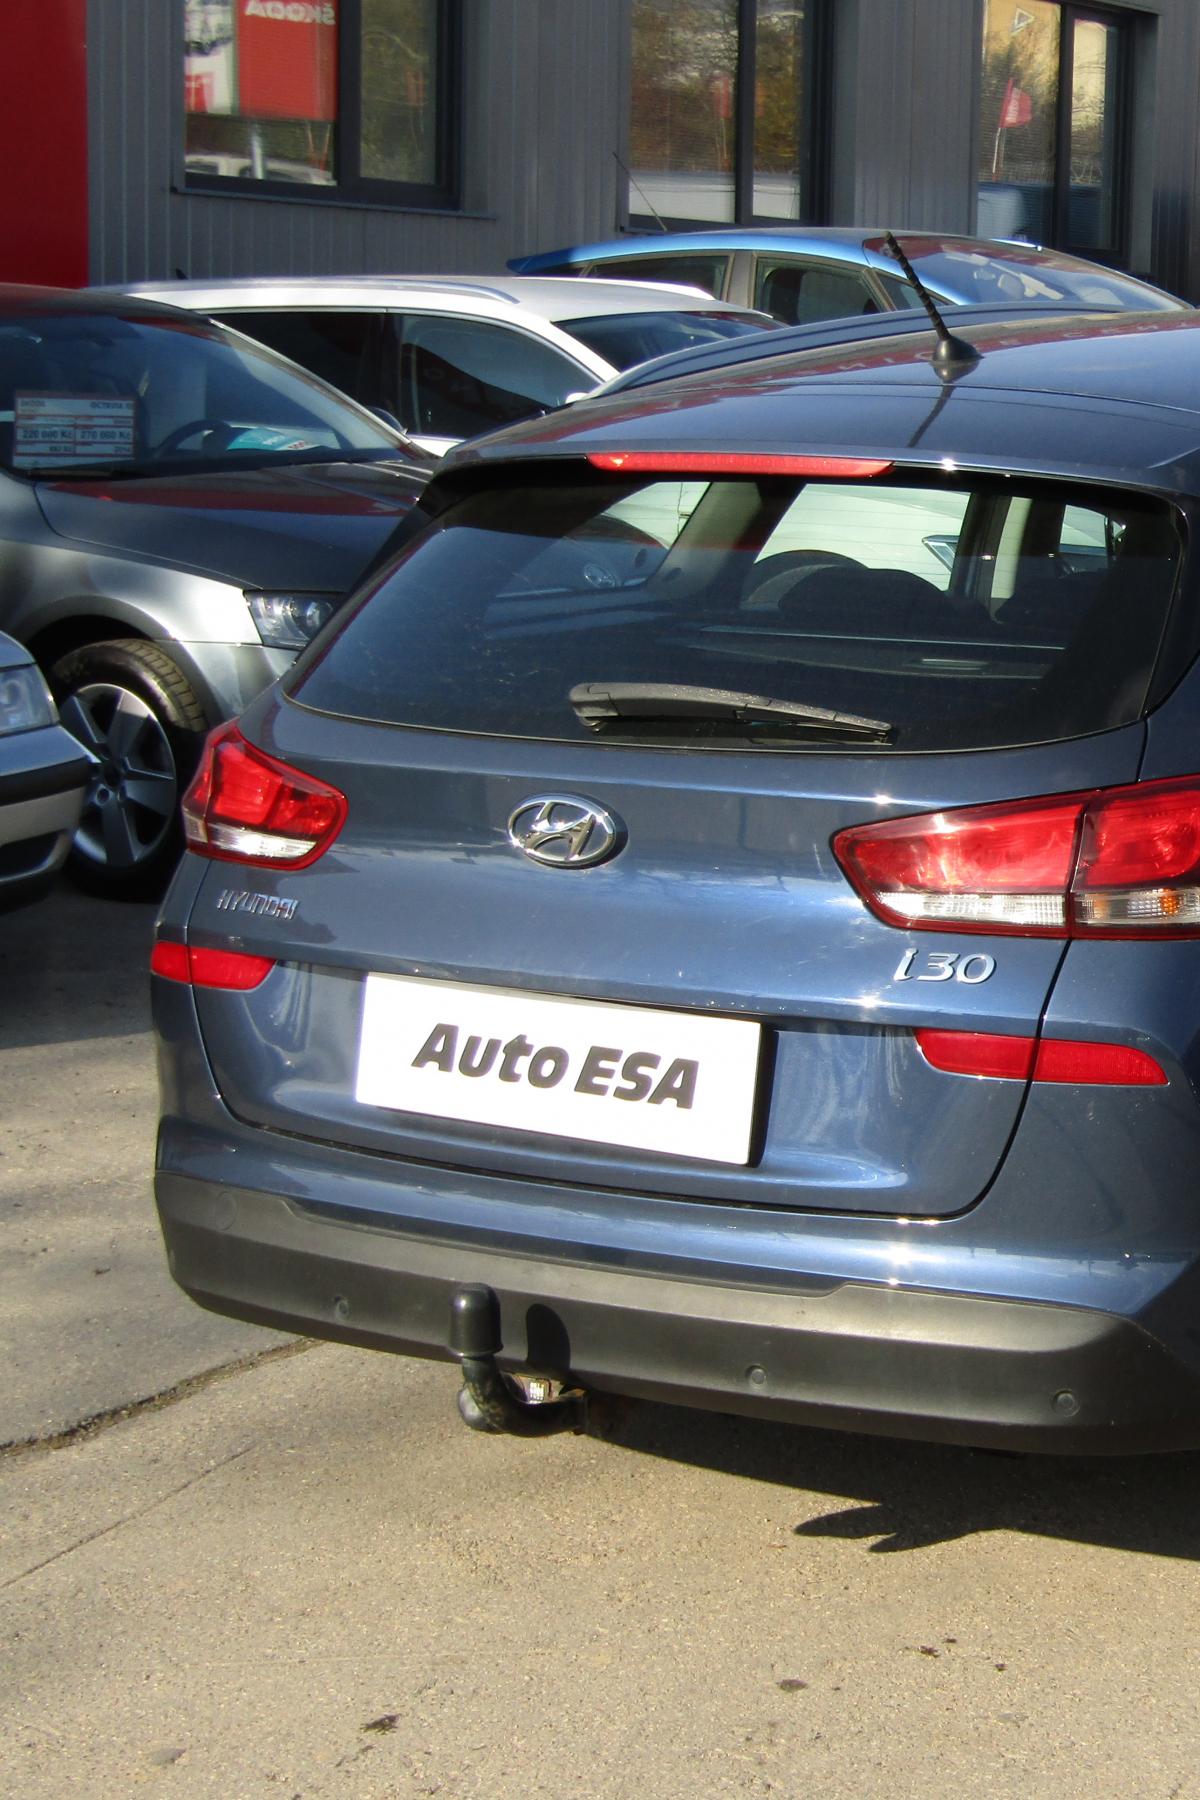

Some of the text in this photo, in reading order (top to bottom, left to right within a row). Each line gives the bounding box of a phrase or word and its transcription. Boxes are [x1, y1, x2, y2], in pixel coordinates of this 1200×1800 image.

[217, 889, 299, 919] HYUNDAI
[893, 947, 997, 985] i30
[410, 1022, 700, 1110] Auto ESA
